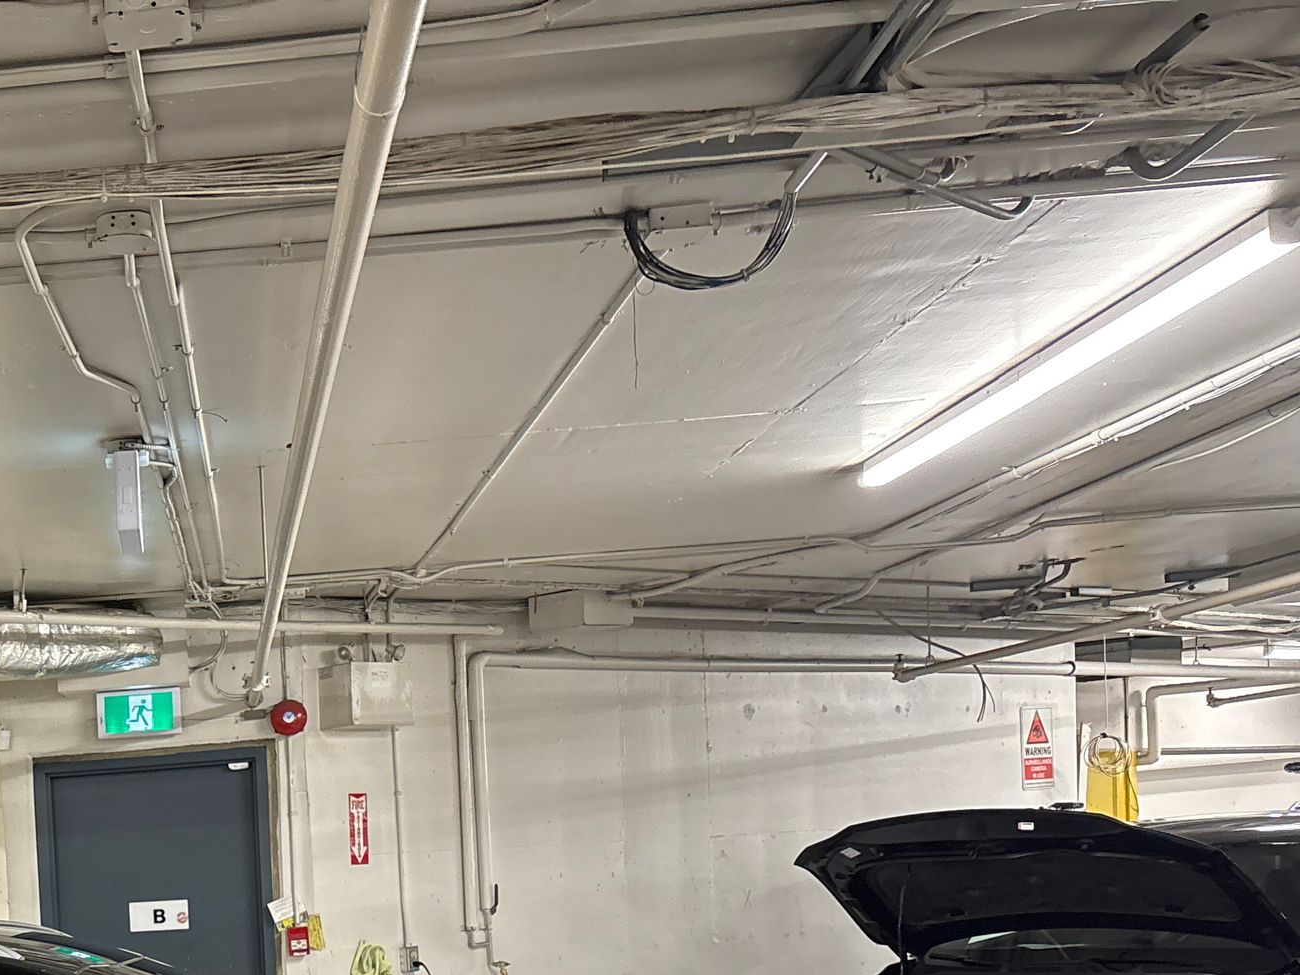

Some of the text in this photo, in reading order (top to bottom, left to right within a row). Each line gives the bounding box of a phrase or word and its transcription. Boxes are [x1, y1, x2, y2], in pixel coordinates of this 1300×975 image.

[1024, 746, 1052, 756] WARNING
[351, 800, 365, 810] FIRE
[153, 909, 166, 924] B
